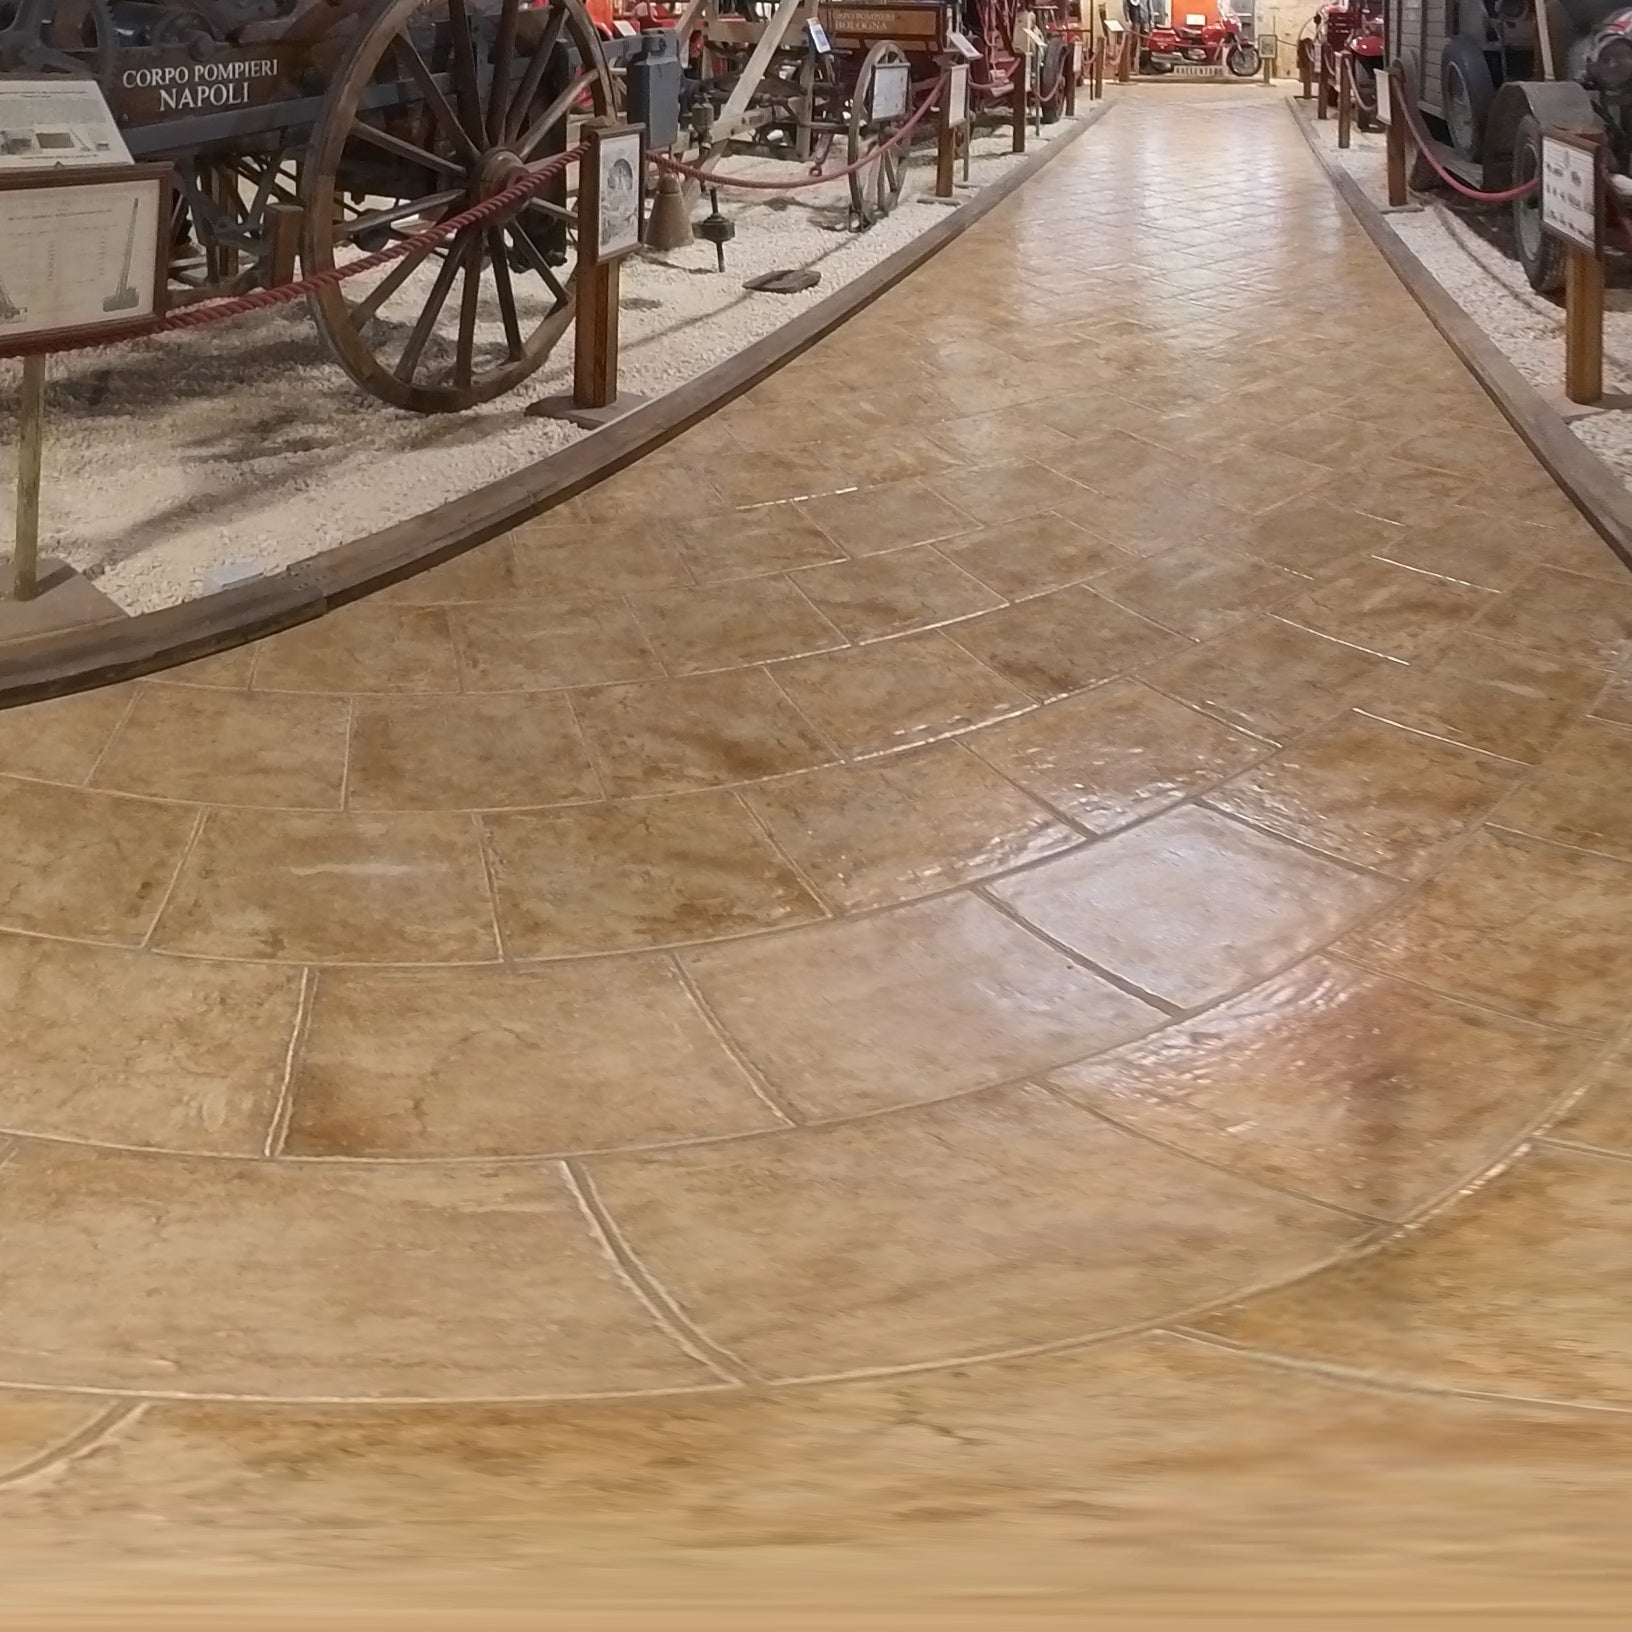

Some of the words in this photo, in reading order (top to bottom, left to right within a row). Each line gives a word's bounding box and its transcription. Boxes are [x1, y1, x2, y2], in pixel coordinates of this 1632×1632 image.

[122, 66, 189, 89] CORPO
[194, 58, 278, 82] POMPIERI
[159, 81, 250, 111] NAPOLI
